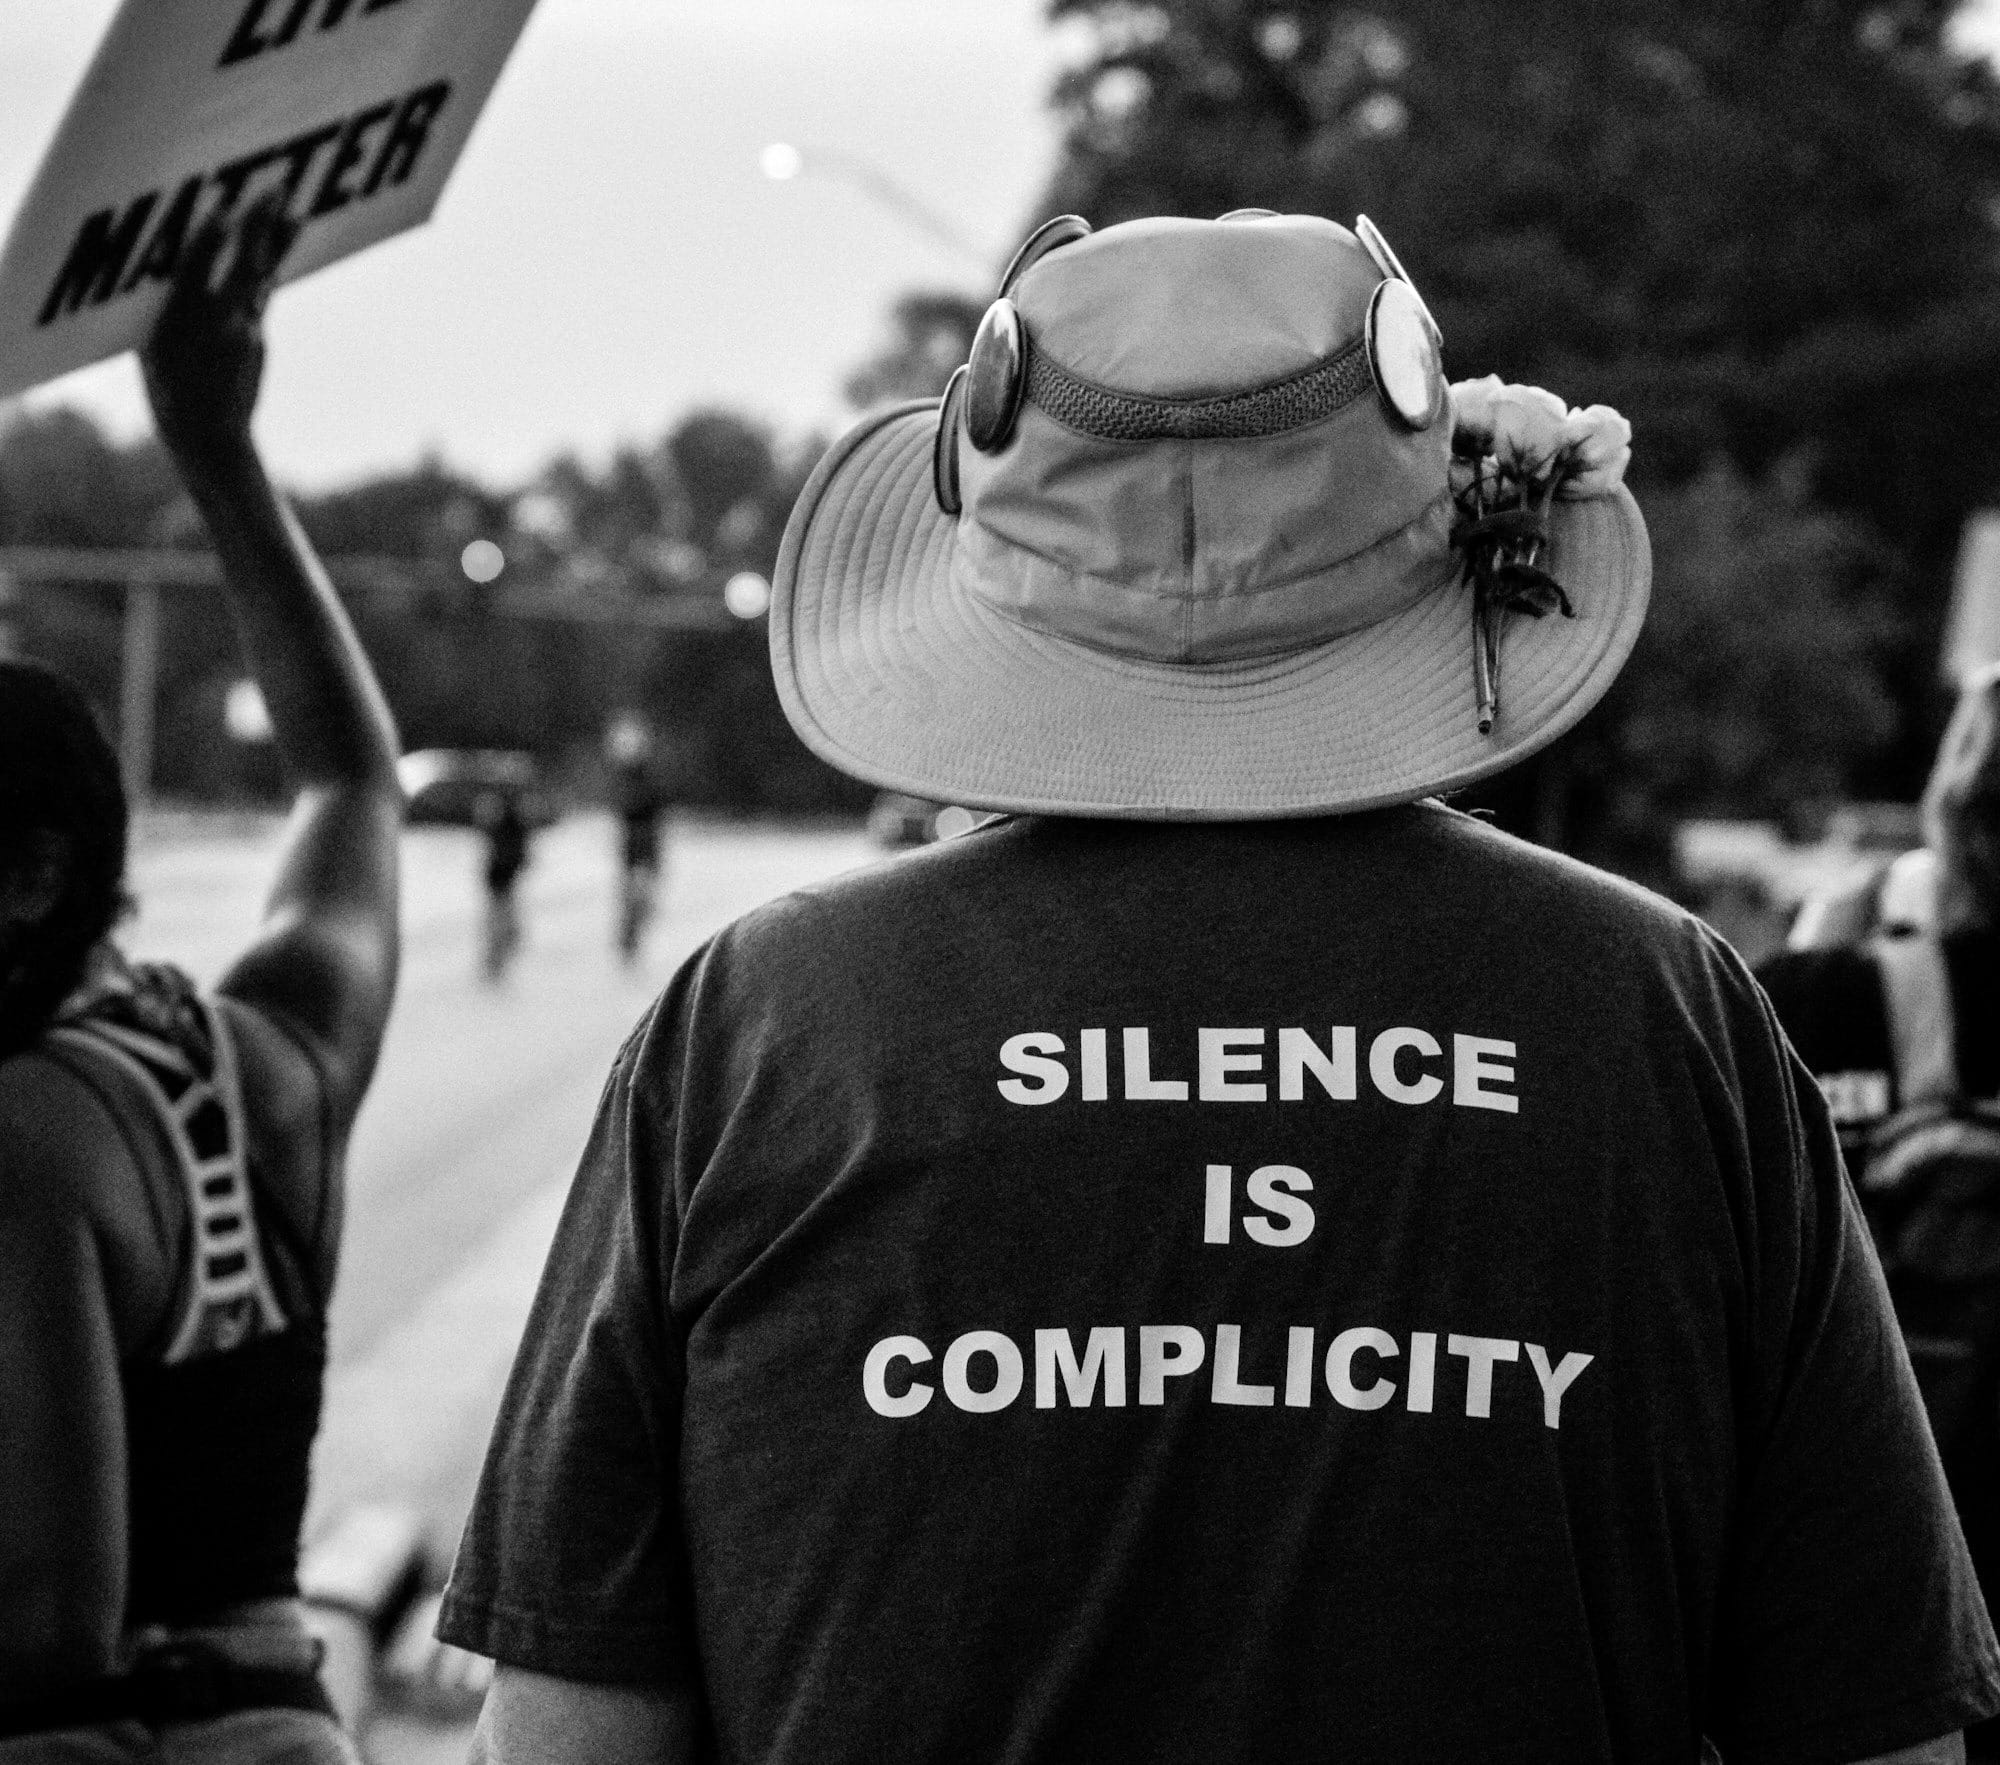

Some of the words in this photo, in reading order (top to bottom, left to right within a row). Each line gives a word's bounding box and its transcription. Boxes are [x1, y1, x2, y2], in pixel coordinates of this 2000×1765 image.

[37, 79, 452, 328] MATTER
[996, 1025, 1519, 1114] SILENCE
[1203, 1164, 1316, 1247] IS
[862, 1324, 1595, 1430] COMPLICITY
